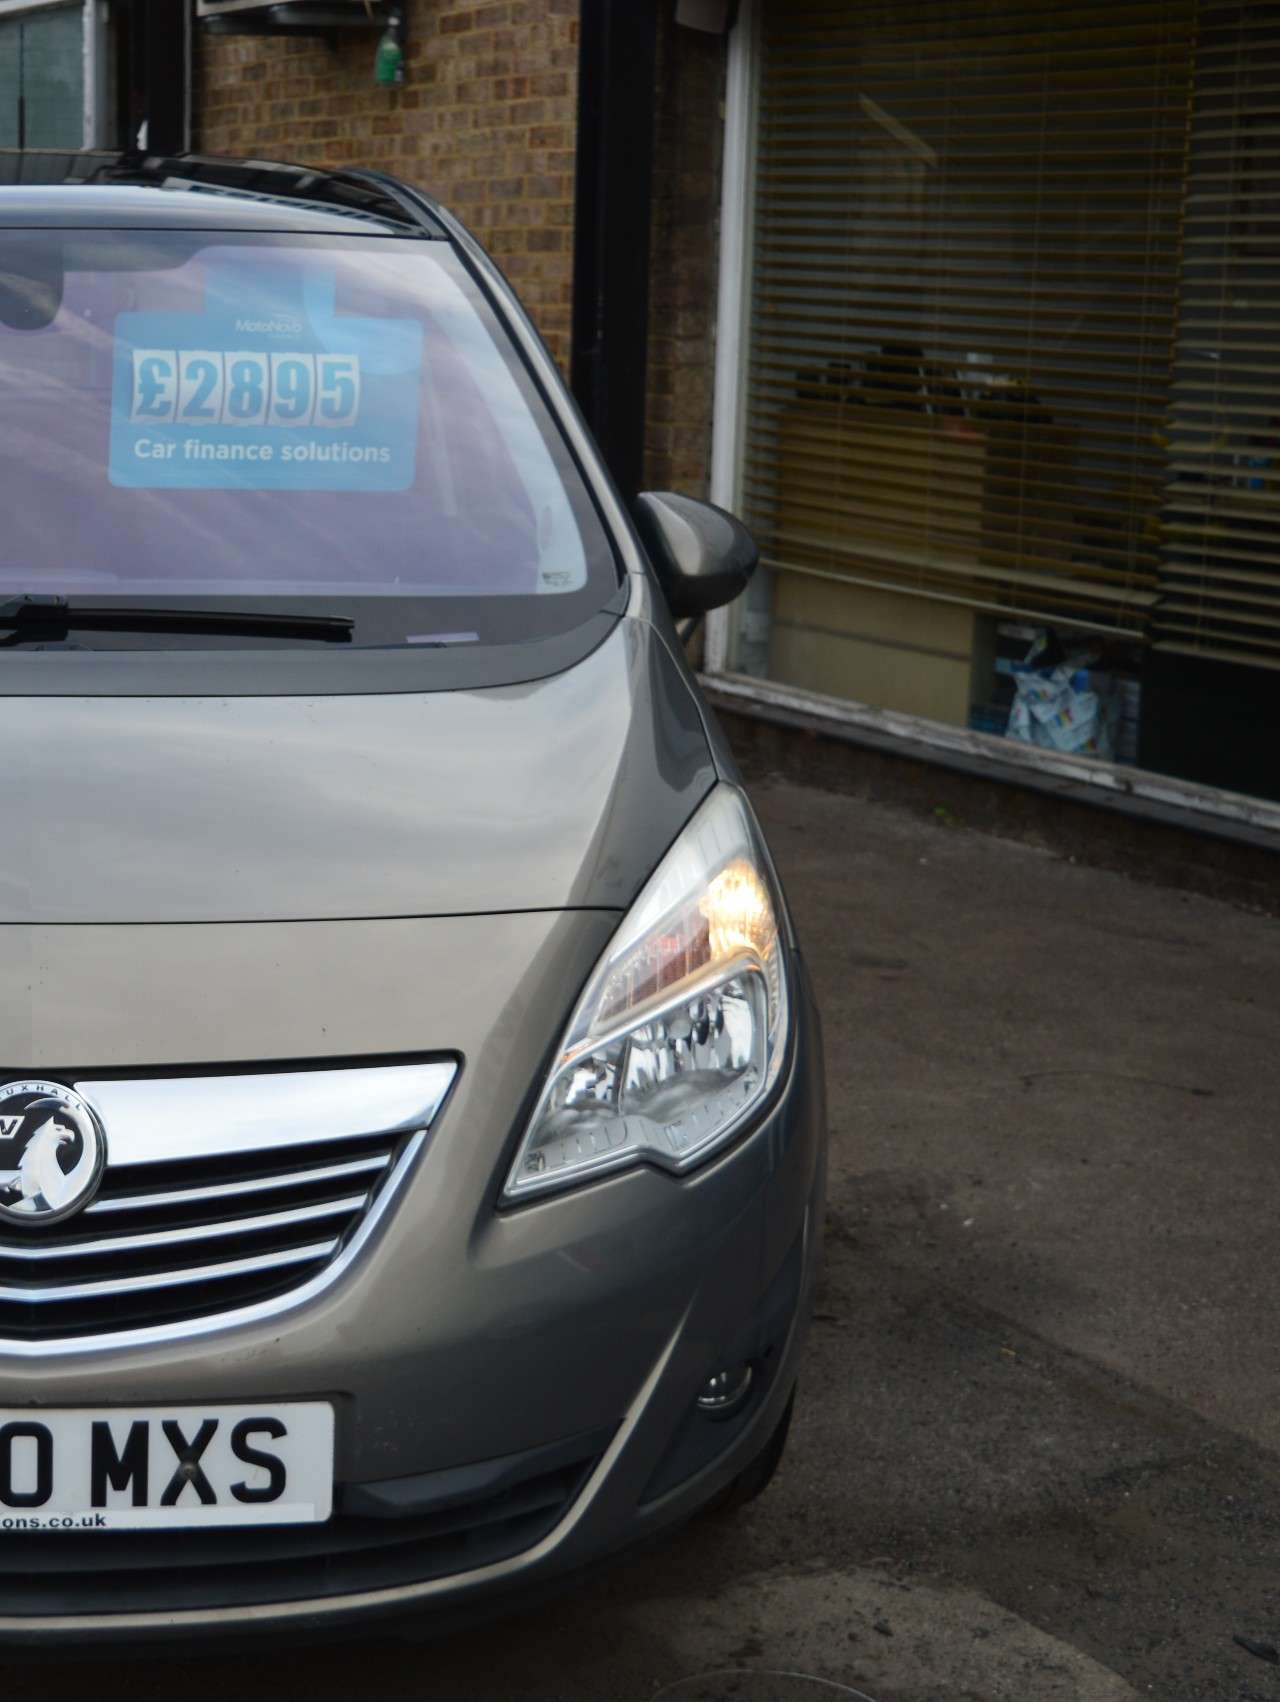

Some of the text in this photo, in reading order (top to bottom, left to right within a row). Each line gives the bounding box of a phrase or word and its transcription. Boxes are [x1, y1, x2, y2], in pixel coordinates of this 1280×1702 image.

[134, 356, 357, 421] £2895
[133, 438, 391, 464] Car finance solutions
[91, 1416, 288, 1508] MXS
